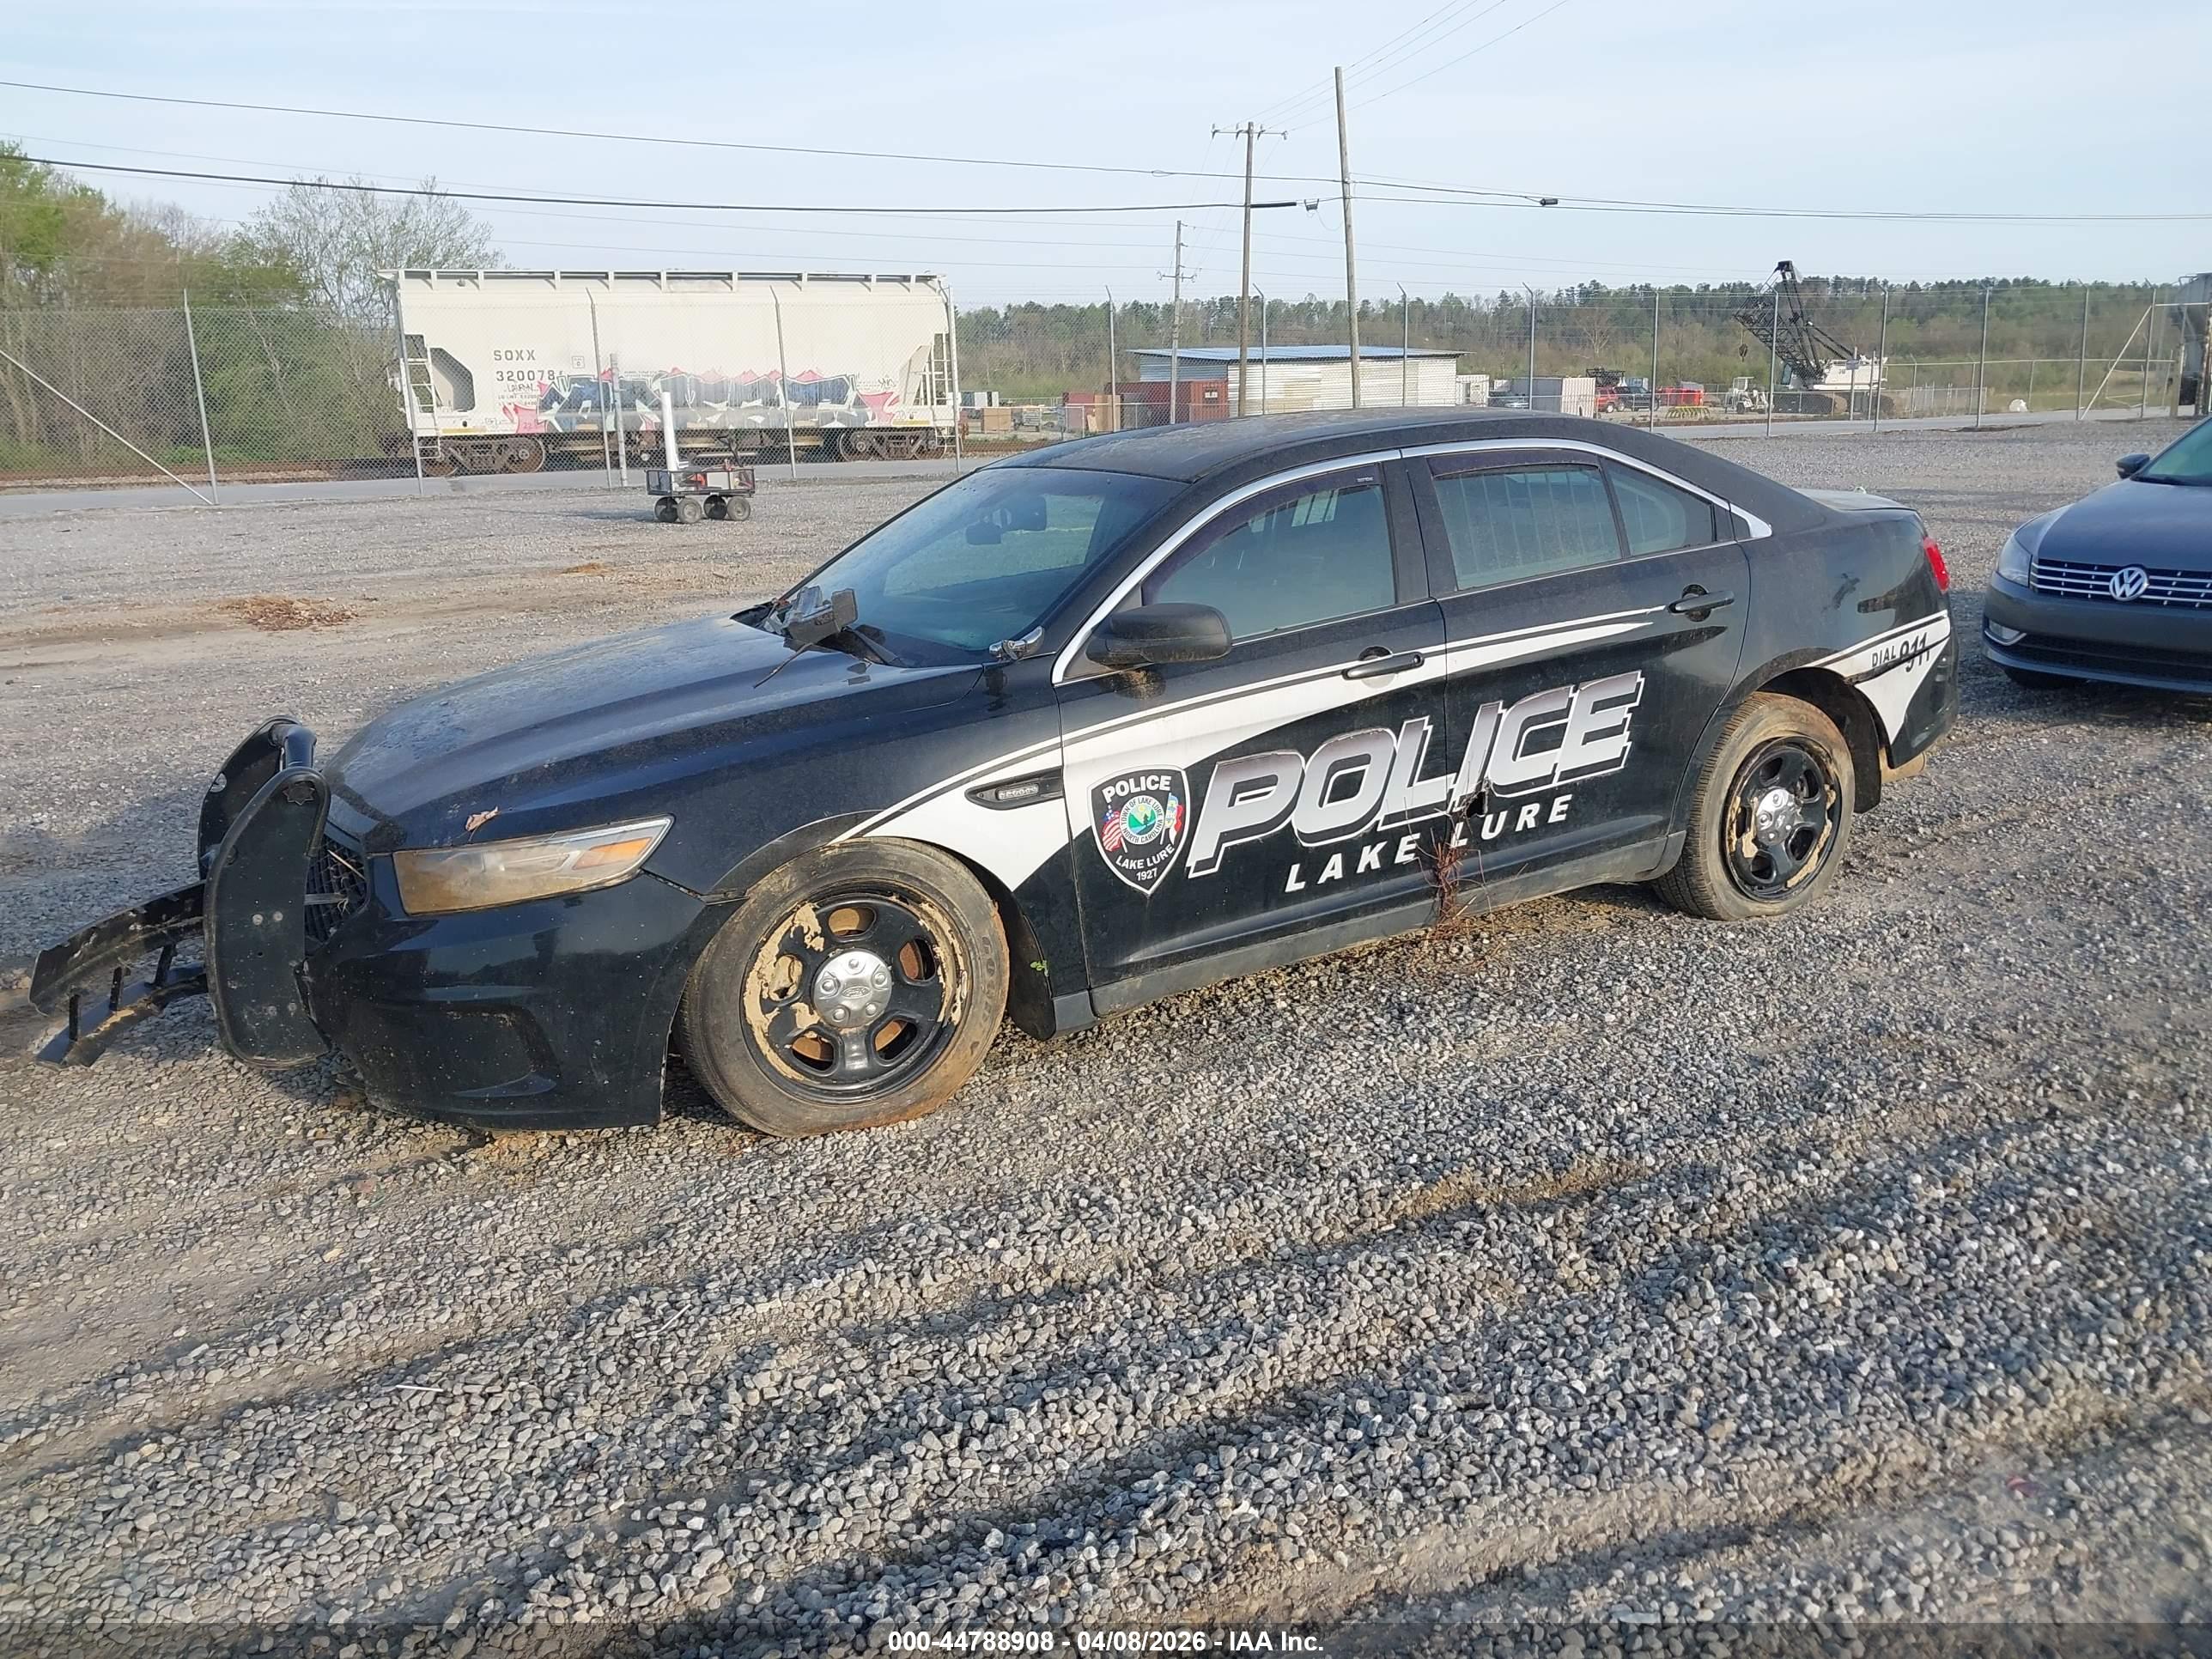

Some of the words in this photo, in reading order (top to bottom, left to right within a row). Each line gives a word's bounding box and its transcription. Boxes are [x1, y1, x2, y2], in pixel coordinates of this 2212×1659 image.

[493, 349, 536, 361] SOXX
[495, 370, 556, 381] 320078
[1871, 645, 1897, 668] DIAL
[1899, 632, 1930, 672] 911
[1187, 670, 1645, 879] POLICE
[1102, 775, 1172, 804] POLICE
[1121, 806, 1131, 826] TOWN
[1128, 799, 1136, 808] OF
[1137, 797, 1153, 805] LAKE
[1152, 801, 1164, 817] LURE
[1121, 827, 1139, 843] NORTH
[1140, 819, 1163, 843] CAROLINA
[1284, 831, 1421, 893] LAKE
[1449, 793, 1573, 849] LURE
[1115, 854, 1145, 870] LAKE
[1146, 843, 1176, 867] LURE
[1136, 867, 1158, 882] 1927
